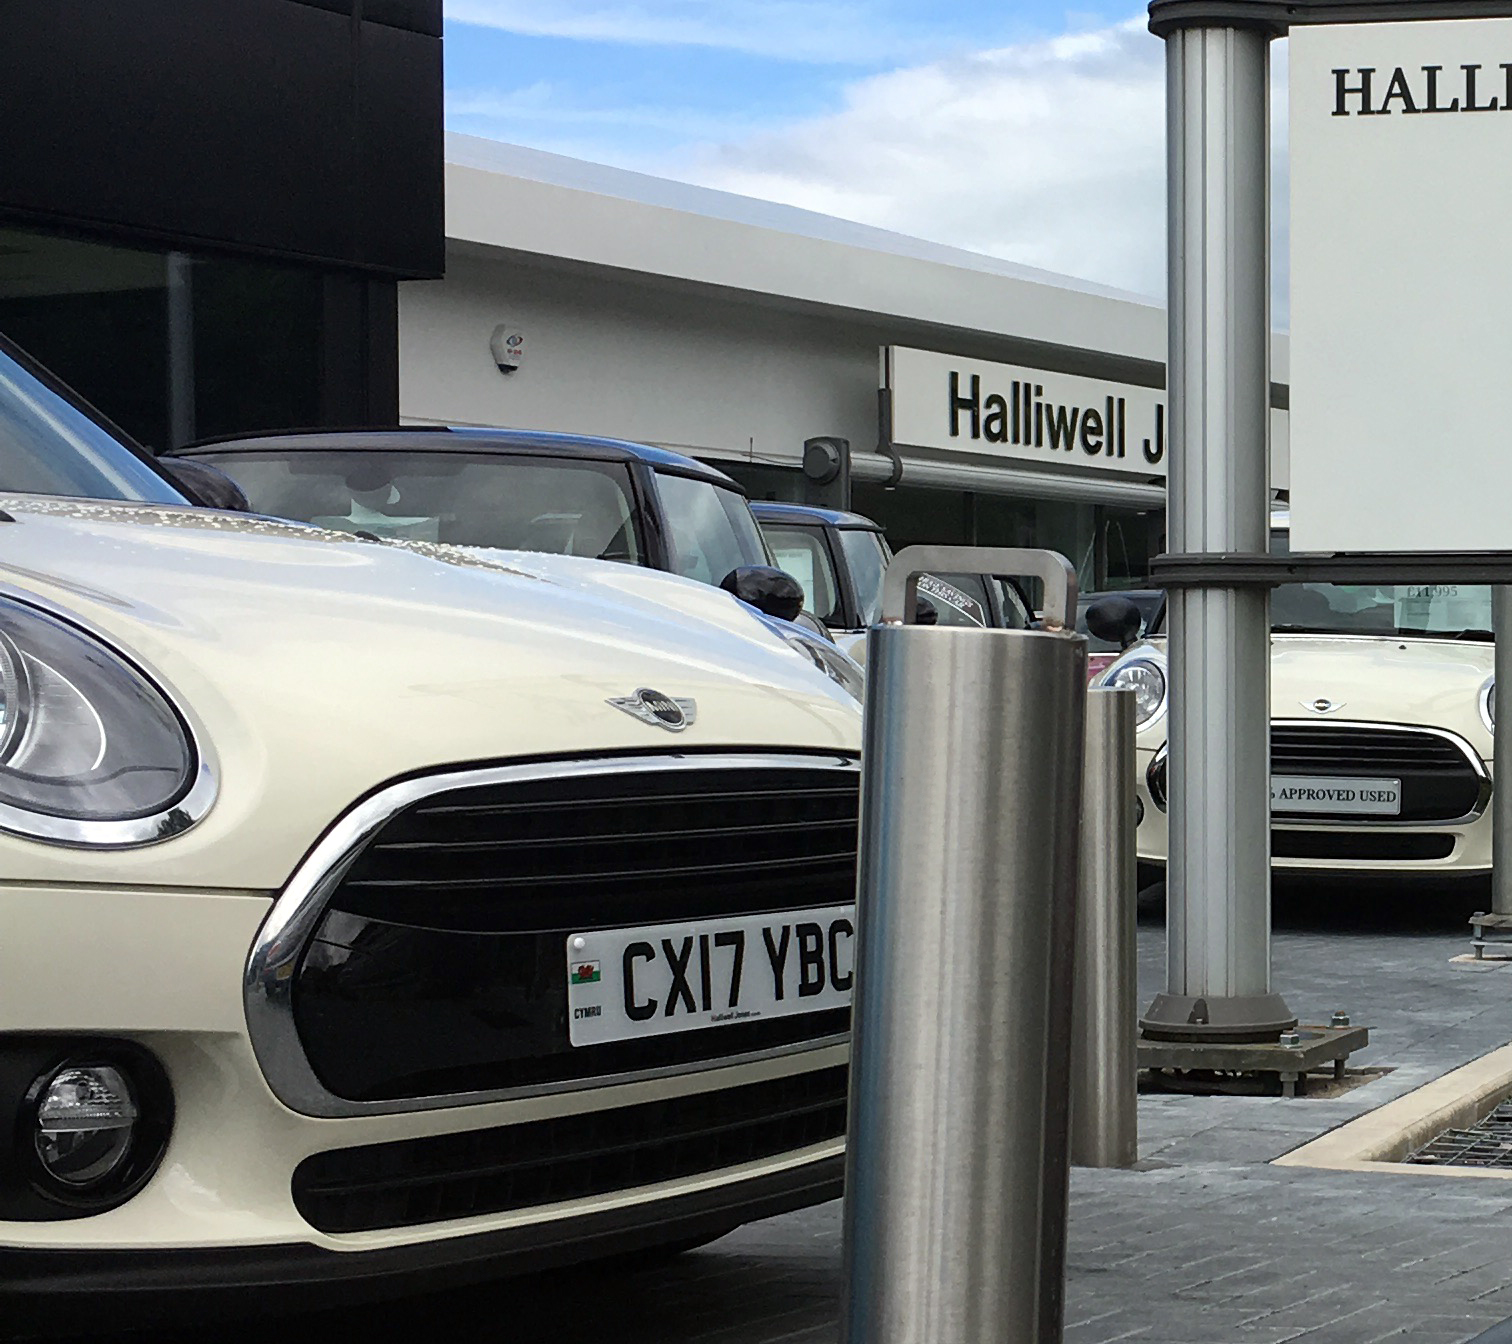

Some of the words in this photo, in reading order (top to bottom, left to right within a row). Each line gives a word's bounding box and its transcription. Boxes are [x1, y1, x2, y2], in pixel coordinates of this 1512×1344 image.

[949, 371, 1126, 458] Halliwell
[1279, 787, 1356, 801] APPROVED
[1360, 789, 1397, 803] USED
[622, 930, 745, 1022] CX17
[762, 918, 854, 1001] YBC
